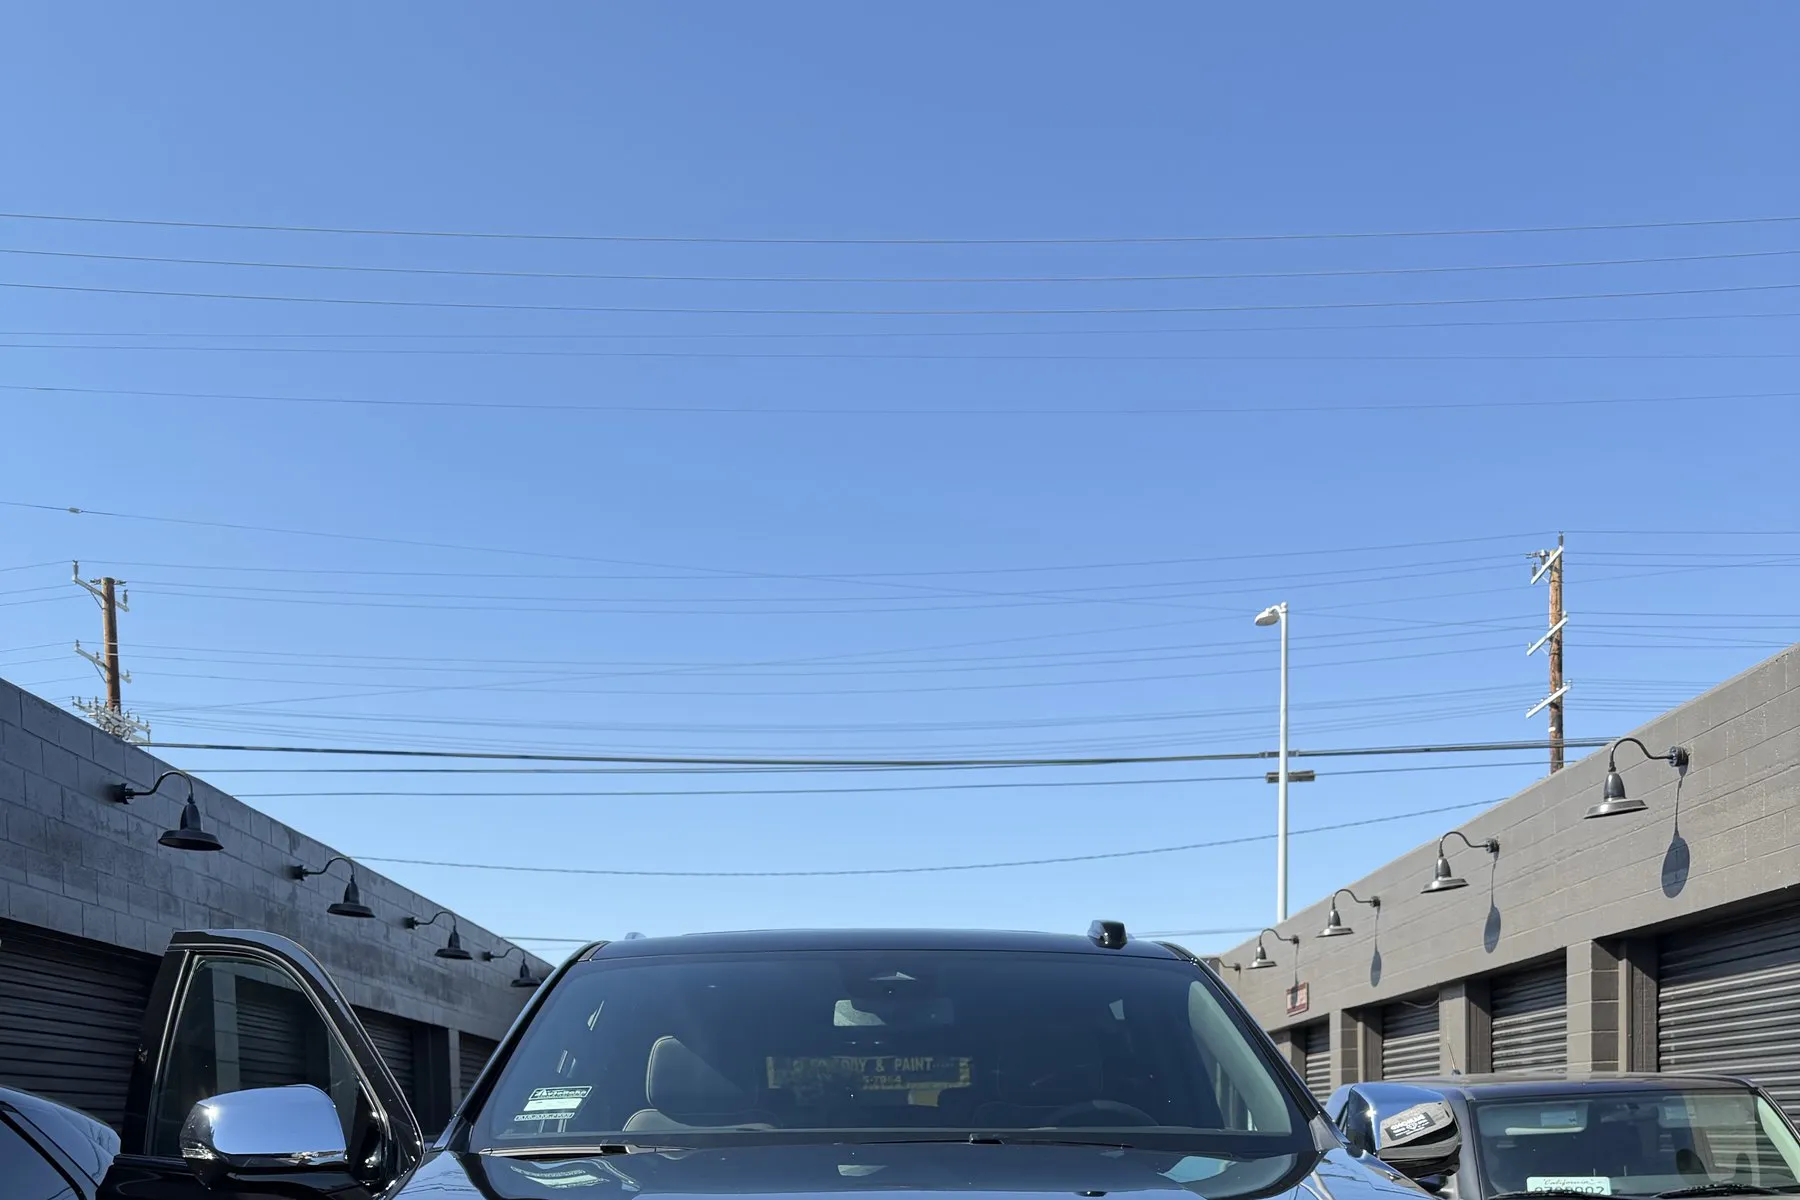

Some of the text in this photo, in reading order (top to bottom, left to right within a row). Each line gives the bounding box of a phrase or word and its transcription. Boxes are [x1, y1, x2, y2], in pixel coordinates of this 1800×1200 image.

[875, 1058, 885, 1072] &
[894, 1057, 934, 1072] PAINT
[1545, 1179, 1589, 1187] California
